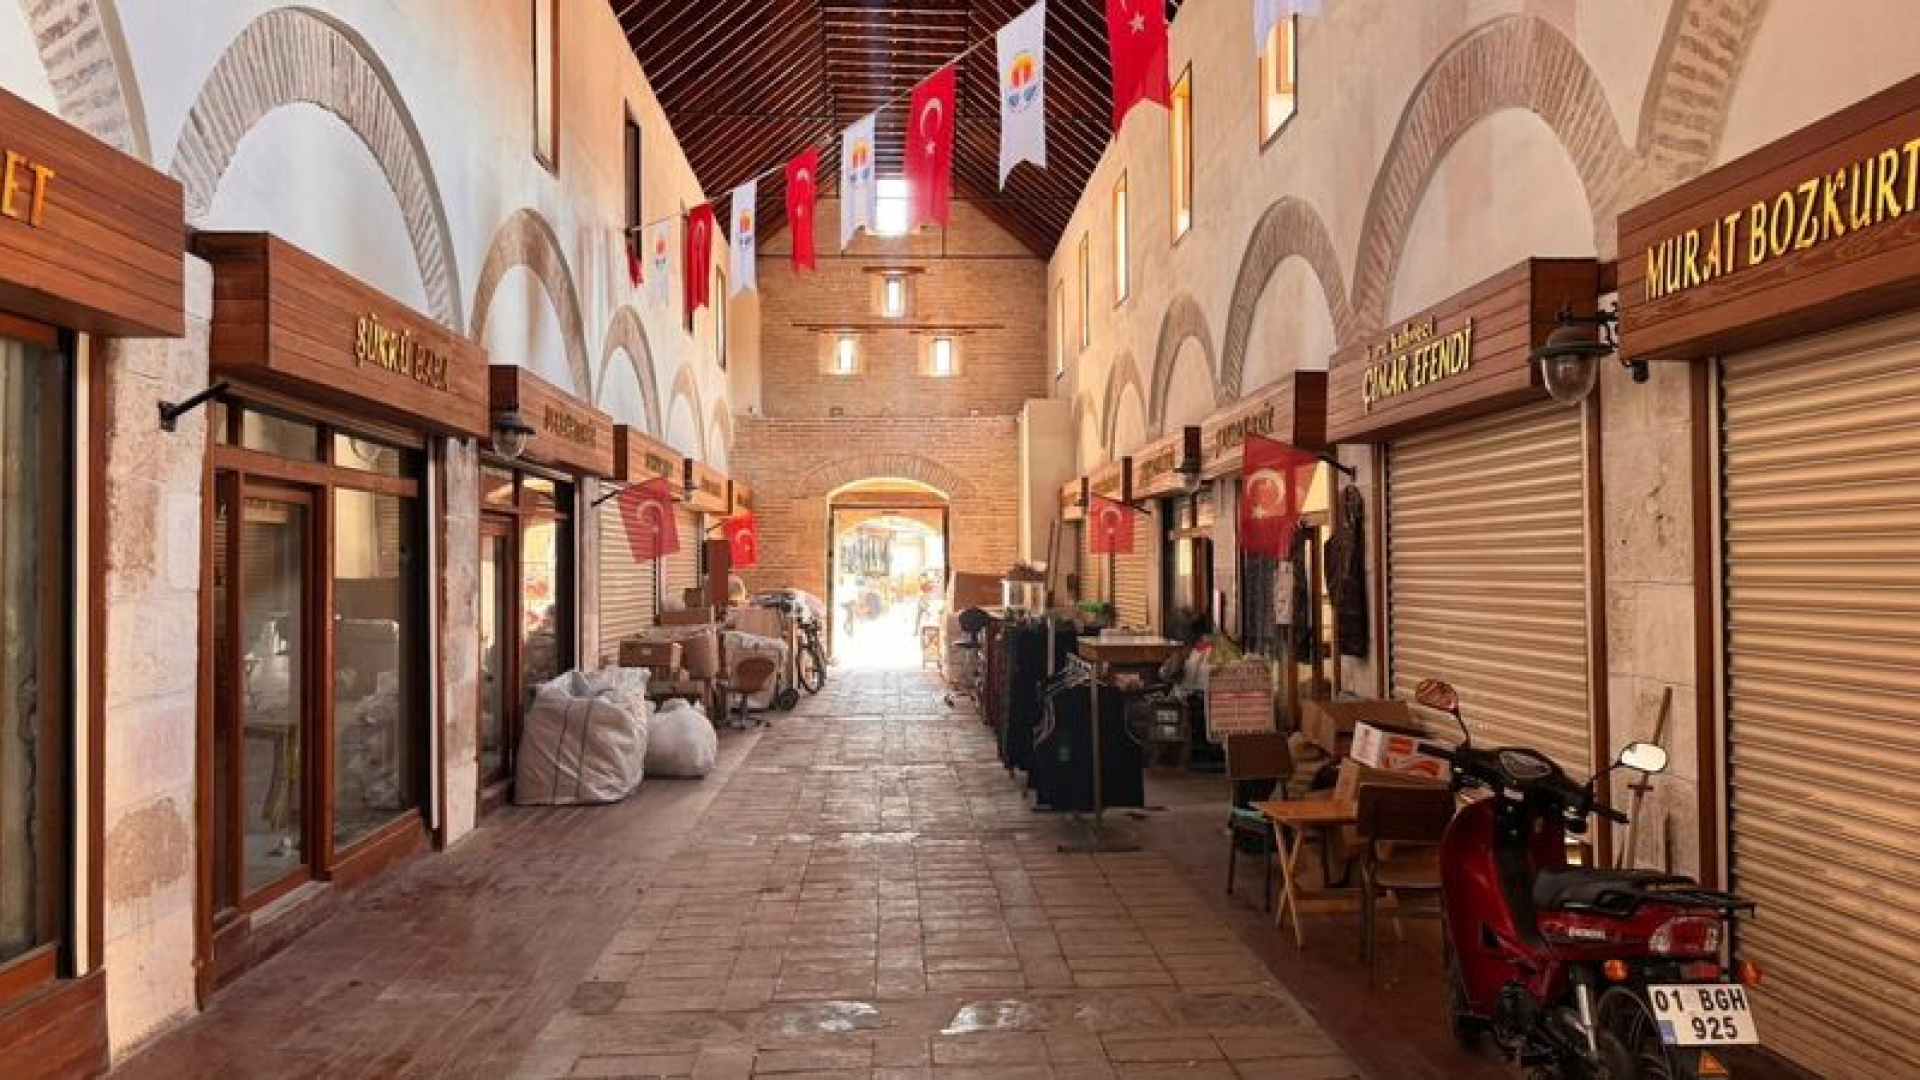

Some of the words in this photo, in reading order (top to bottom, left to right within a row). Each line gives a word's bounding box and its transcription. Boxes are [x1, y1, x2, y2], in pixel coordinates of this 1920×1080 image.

[1645, 211, 1742, 301] MURAT
[1749, 138, 1920, 266] BOZKURT
[354, 312, 411, 374] ŞÜKRÜ
[1362, 353, 1408, 416] ÇINAR
[1413, 317, 1473, 388] EFENDİ
[1654, 988, 1684, 1013] 01
[1698, 988, 1747, 1012] BGH
[1691, 1016, 1739, 1040] 925
